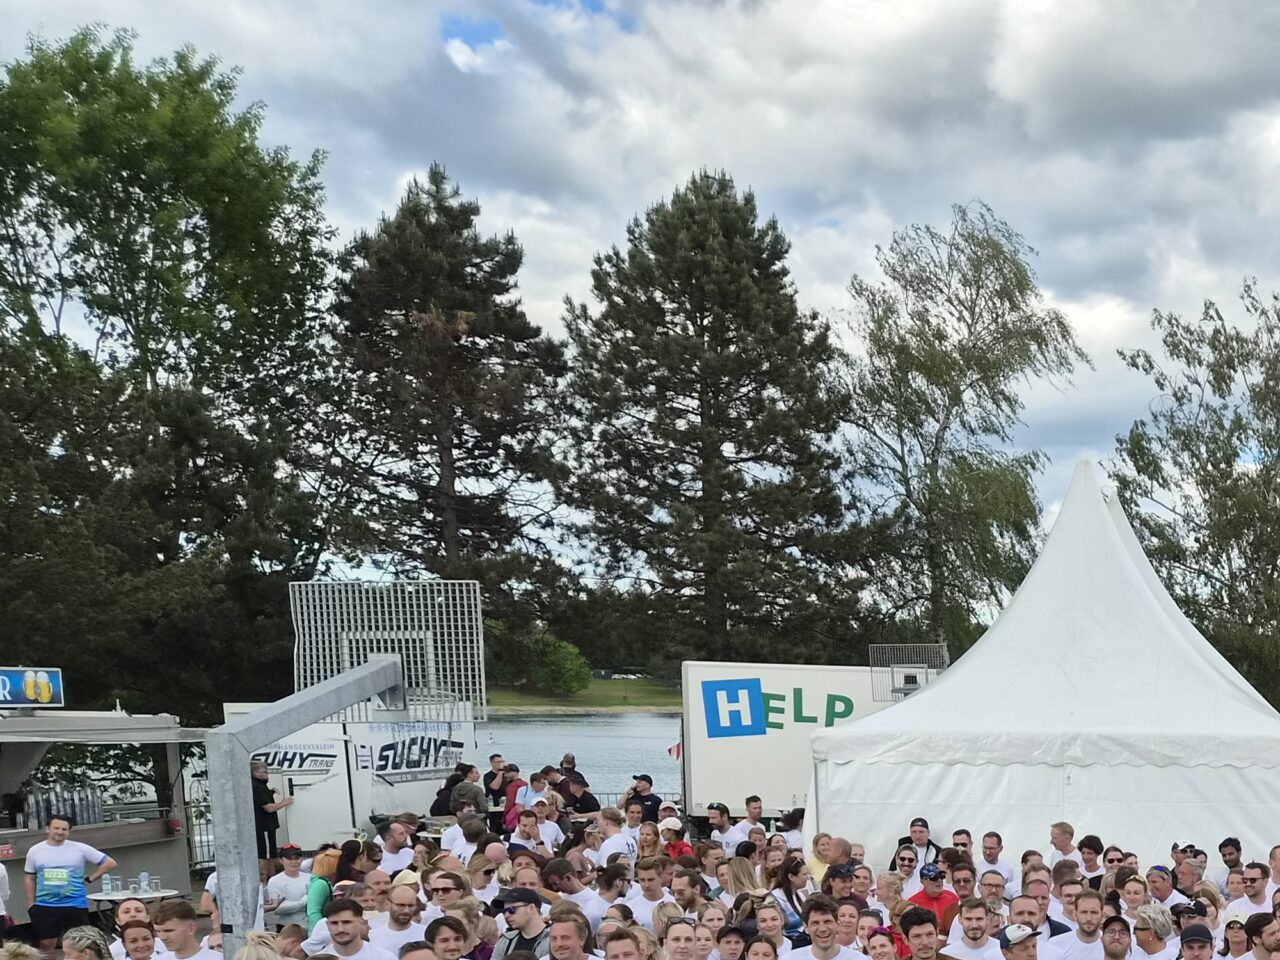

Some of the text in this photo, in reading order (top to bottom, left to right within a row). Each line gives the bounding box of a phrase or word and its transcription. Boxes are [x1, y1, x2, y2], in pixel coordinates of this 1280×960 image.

[716, 687, 855, 730] HELP
[251, 751, 337, 768] SUHY
[309, 760, 335, 768] TRANS
[375, 736, 464, 771] SUCHY
